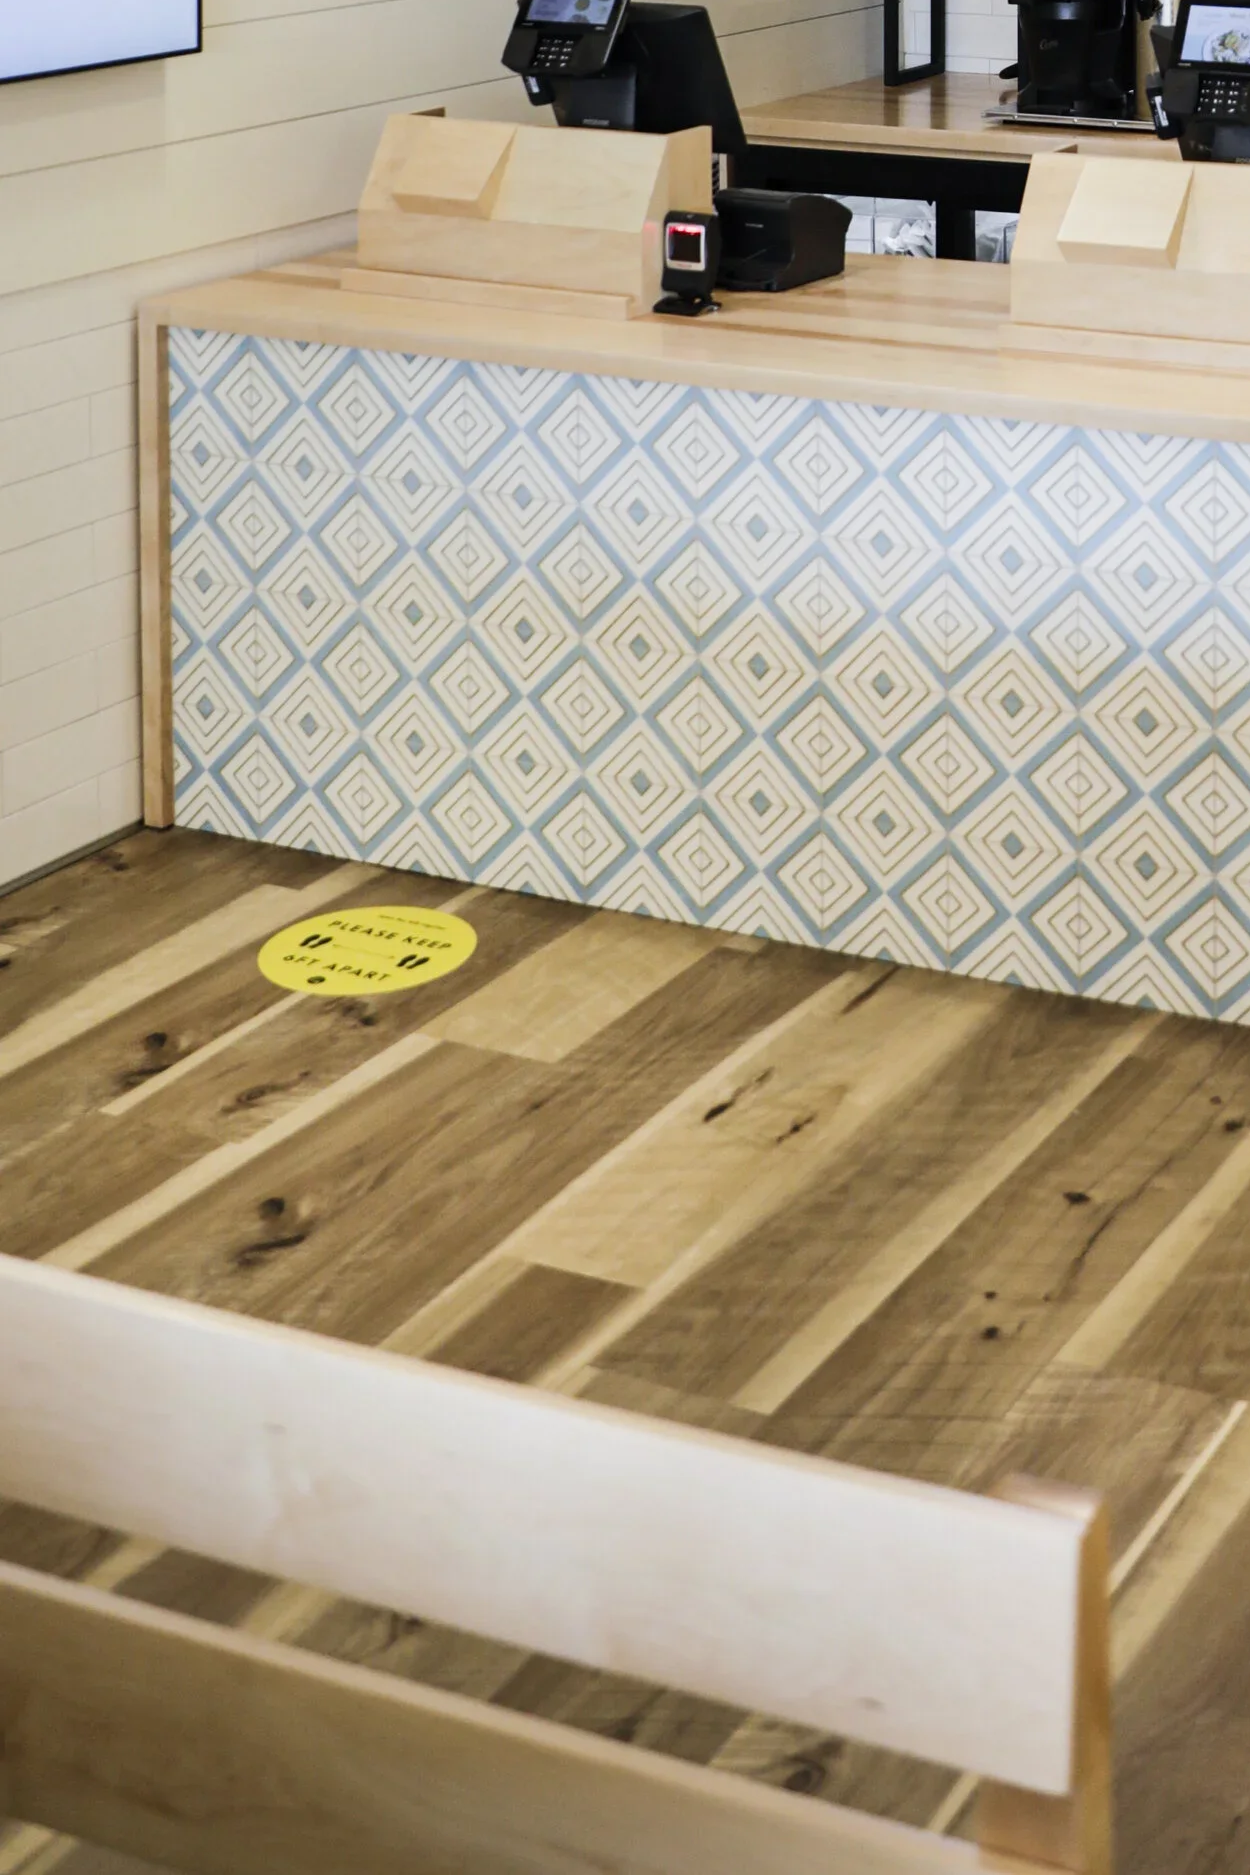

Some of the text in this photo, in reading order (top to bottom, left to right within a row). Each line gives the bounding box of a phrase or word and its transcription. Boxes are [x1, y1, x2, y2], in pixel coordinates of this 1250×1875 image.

[328, 919, 399, 941] PLEASE
[402, 935, 453, 950] KEEP
[283, 953, 391, 982] 6FT APART
